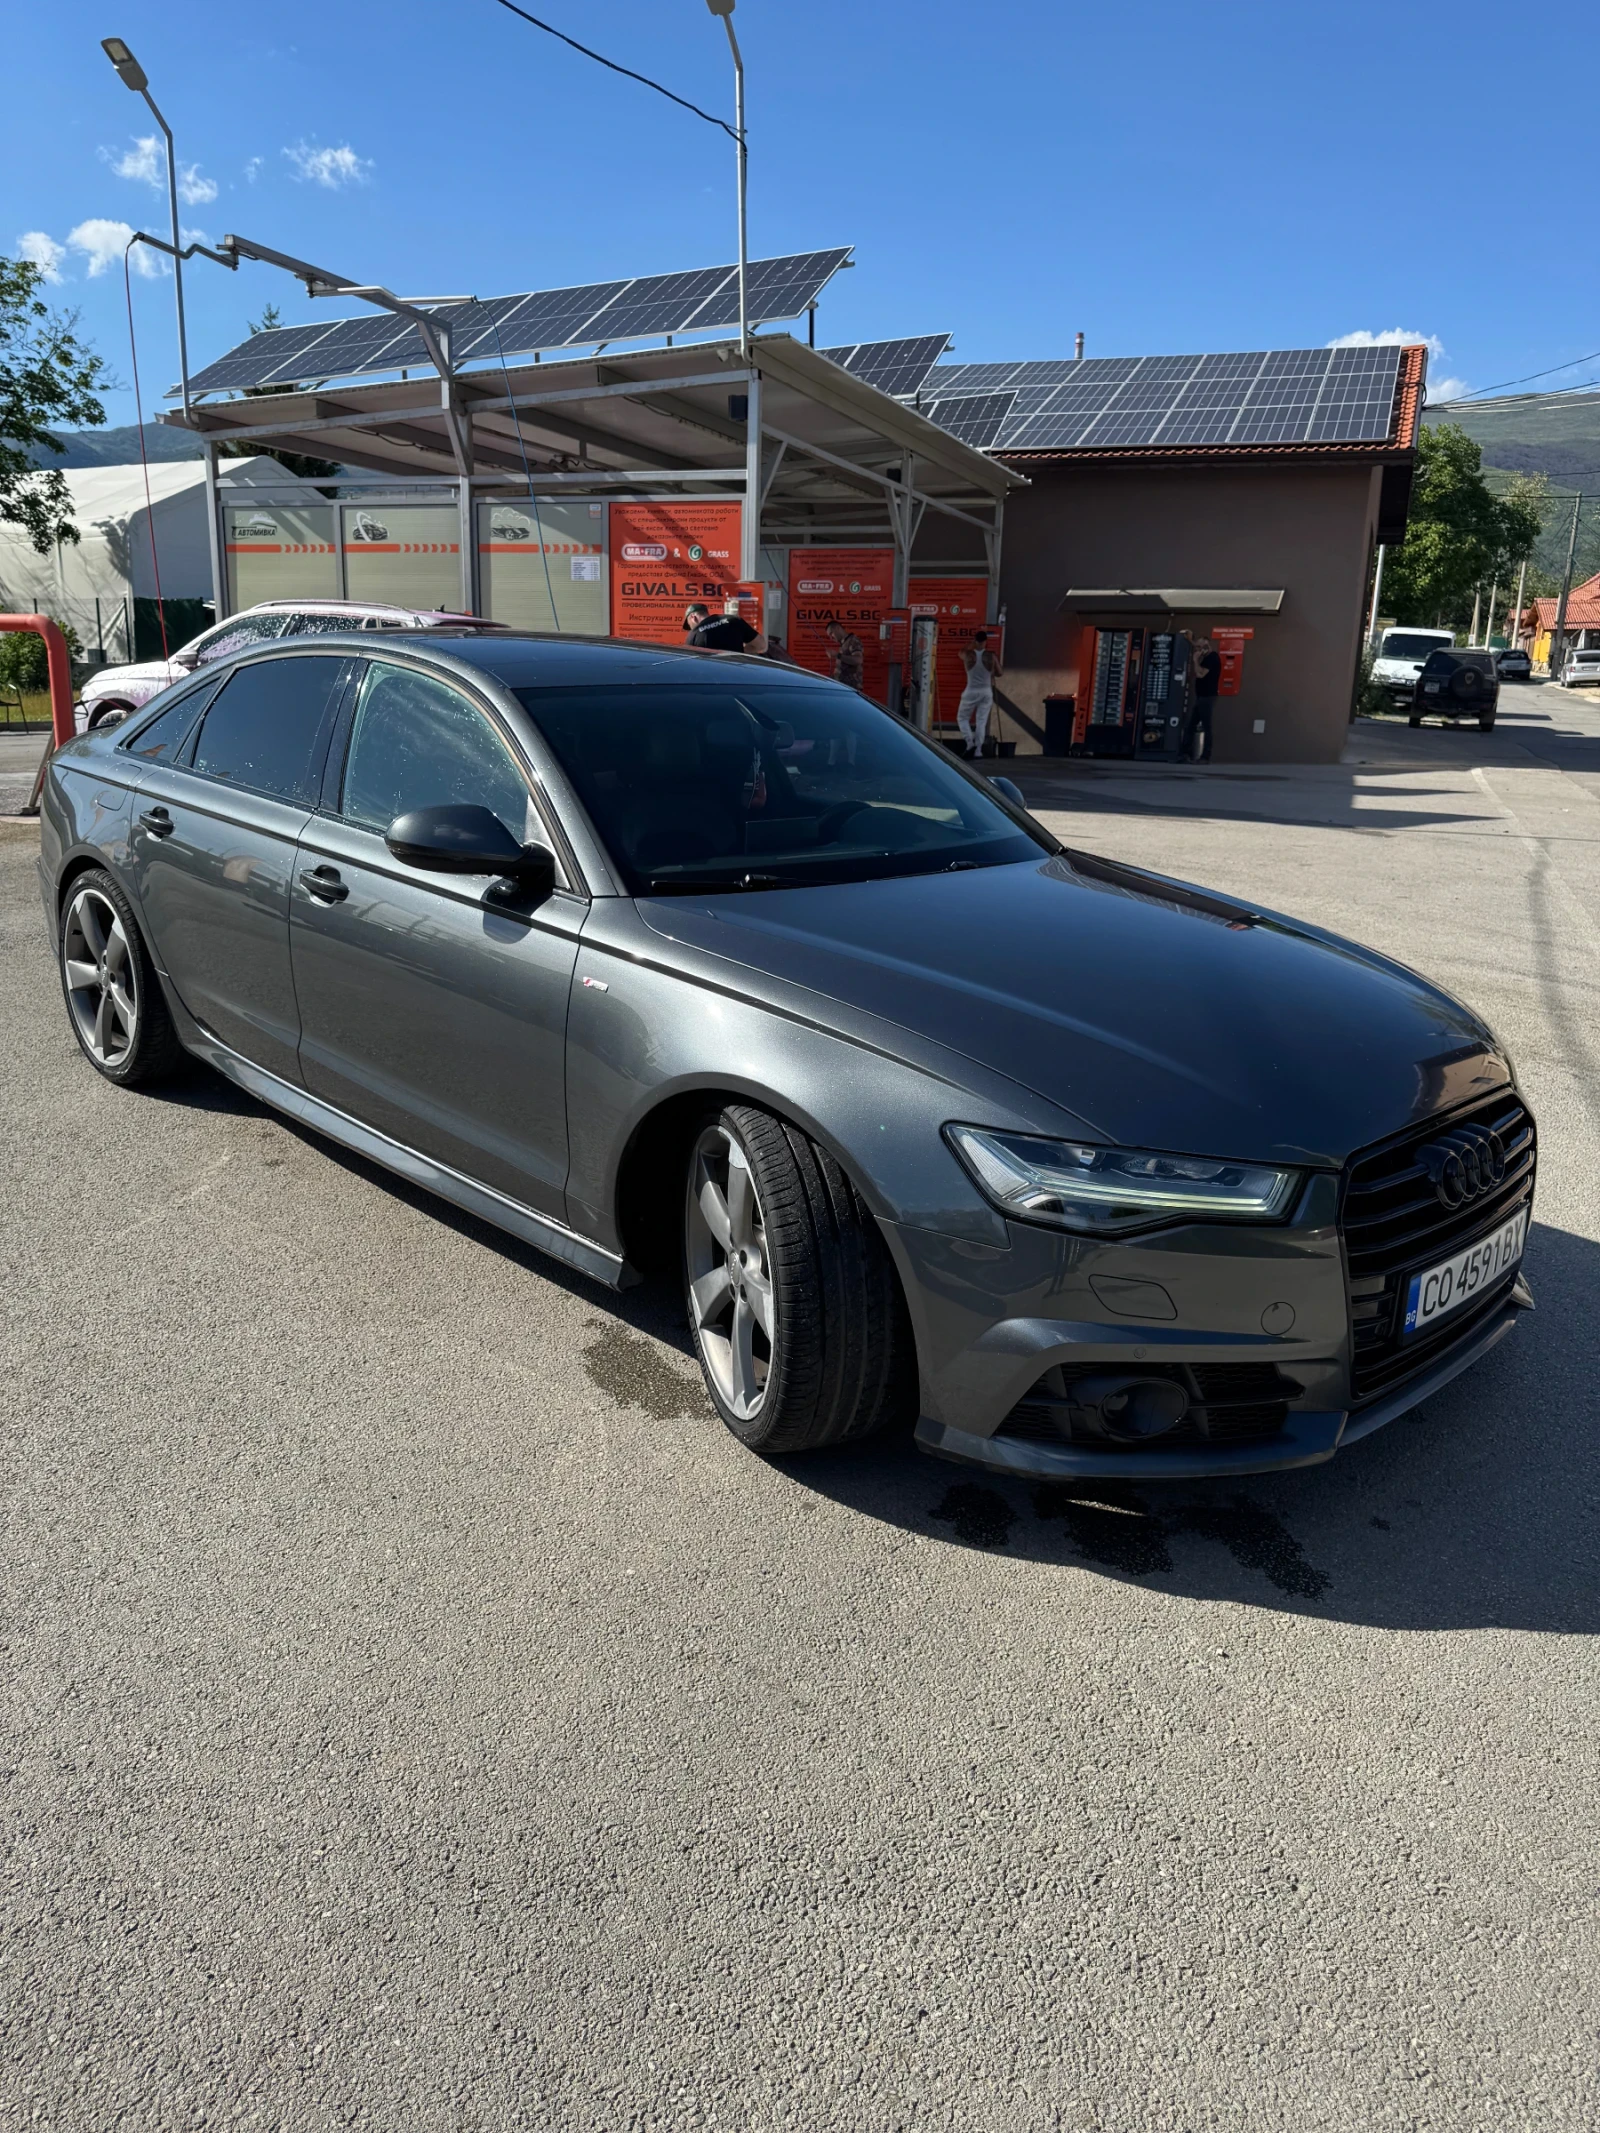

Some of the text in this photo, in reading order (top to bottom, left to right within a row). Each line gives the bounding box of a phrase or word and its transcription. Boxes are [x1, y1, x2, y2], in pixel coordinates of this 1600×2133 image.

[707, 550, 729, 558] GRASS
[629, 614, 673, 622] Инструкции
[796, 609, 880, 620] GIVALS.BG
[1405, 1310, 1417, 1326] BG
